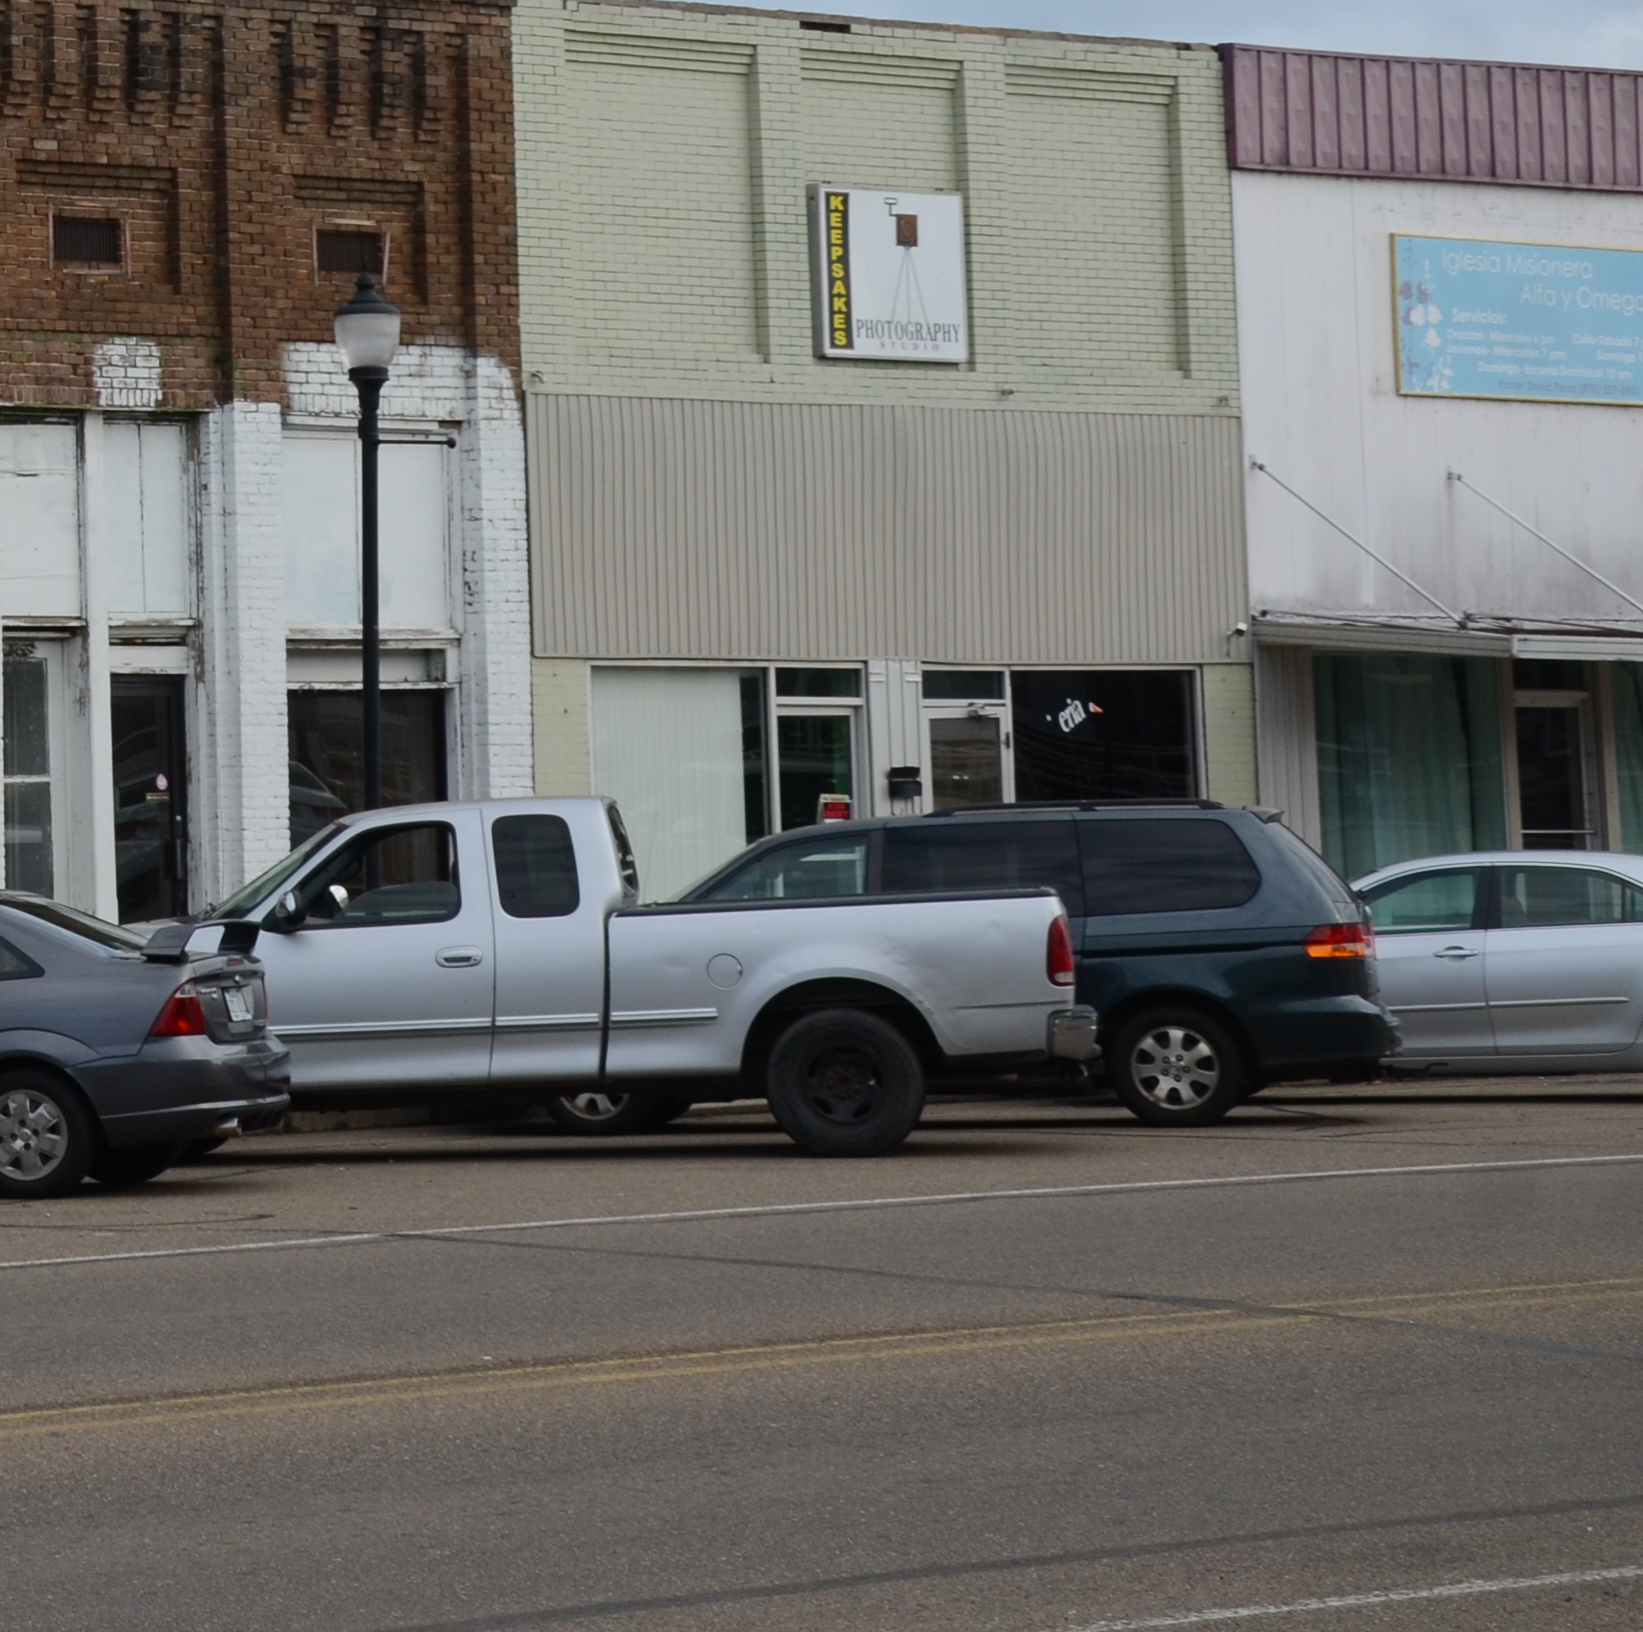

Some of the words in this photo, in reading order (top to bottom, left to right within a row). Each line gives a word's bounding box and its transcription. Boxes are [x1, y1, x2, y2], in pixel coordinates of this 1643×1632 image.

[829, 195, 848, 346] KEEPSAKES
[1442, 248, 1500, 275] Iglesia
[1505, 252, 1593, 279] Misionera
[1520, 283, 1555, 306] Alfa
[1560, 290, 1571, 311] y
[856, 318, 961, 344] PHOTOGRAPHY
[880, 341, 940, 352] STUDIO
